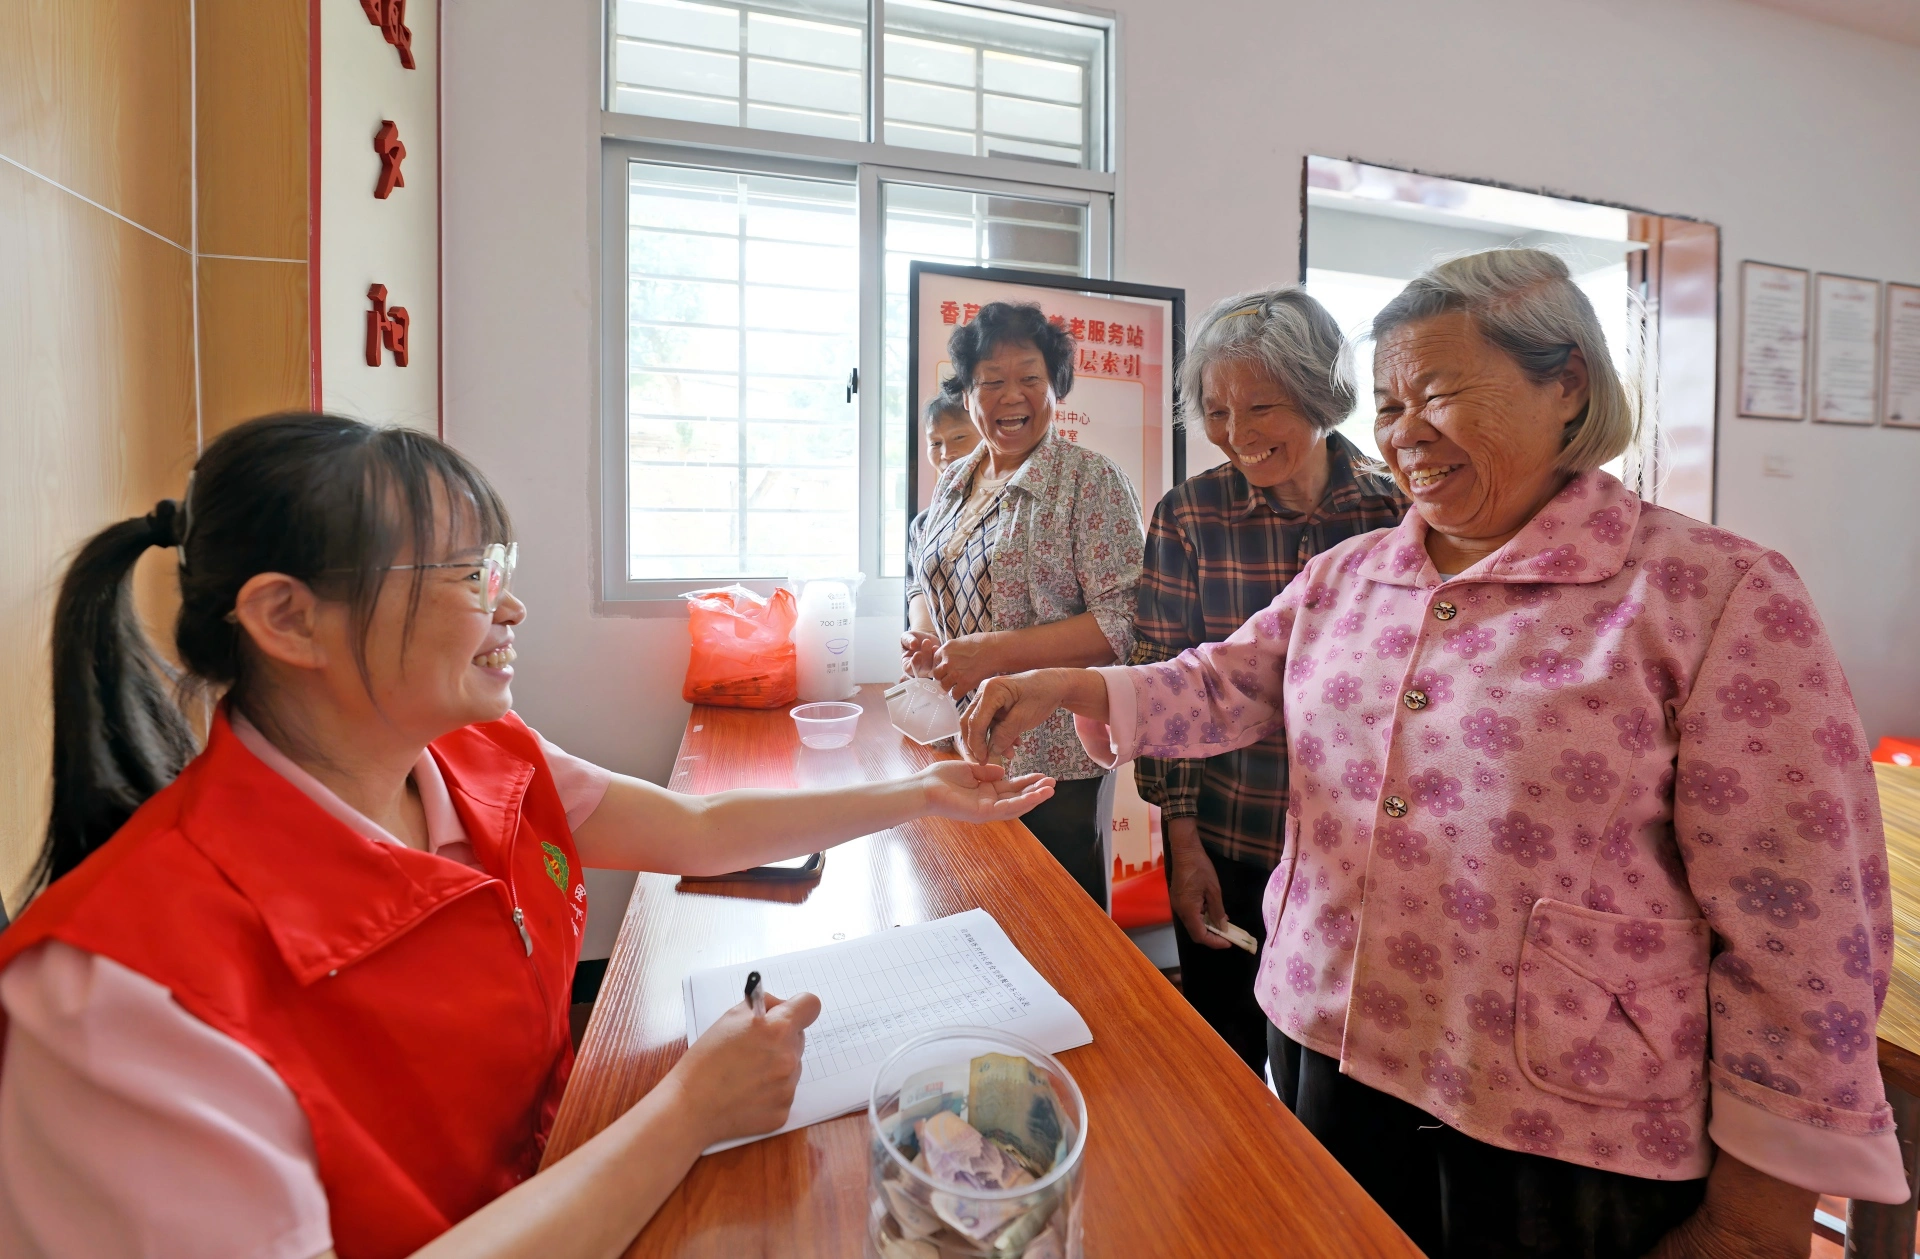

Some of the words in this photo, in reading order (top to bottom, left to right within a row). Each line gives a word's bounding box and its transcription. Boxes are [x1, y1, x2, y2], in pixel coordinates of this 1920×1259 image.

[1073, 348, 1140, 377] 层索引
[1052, 409, 1091, 426] 料中心
